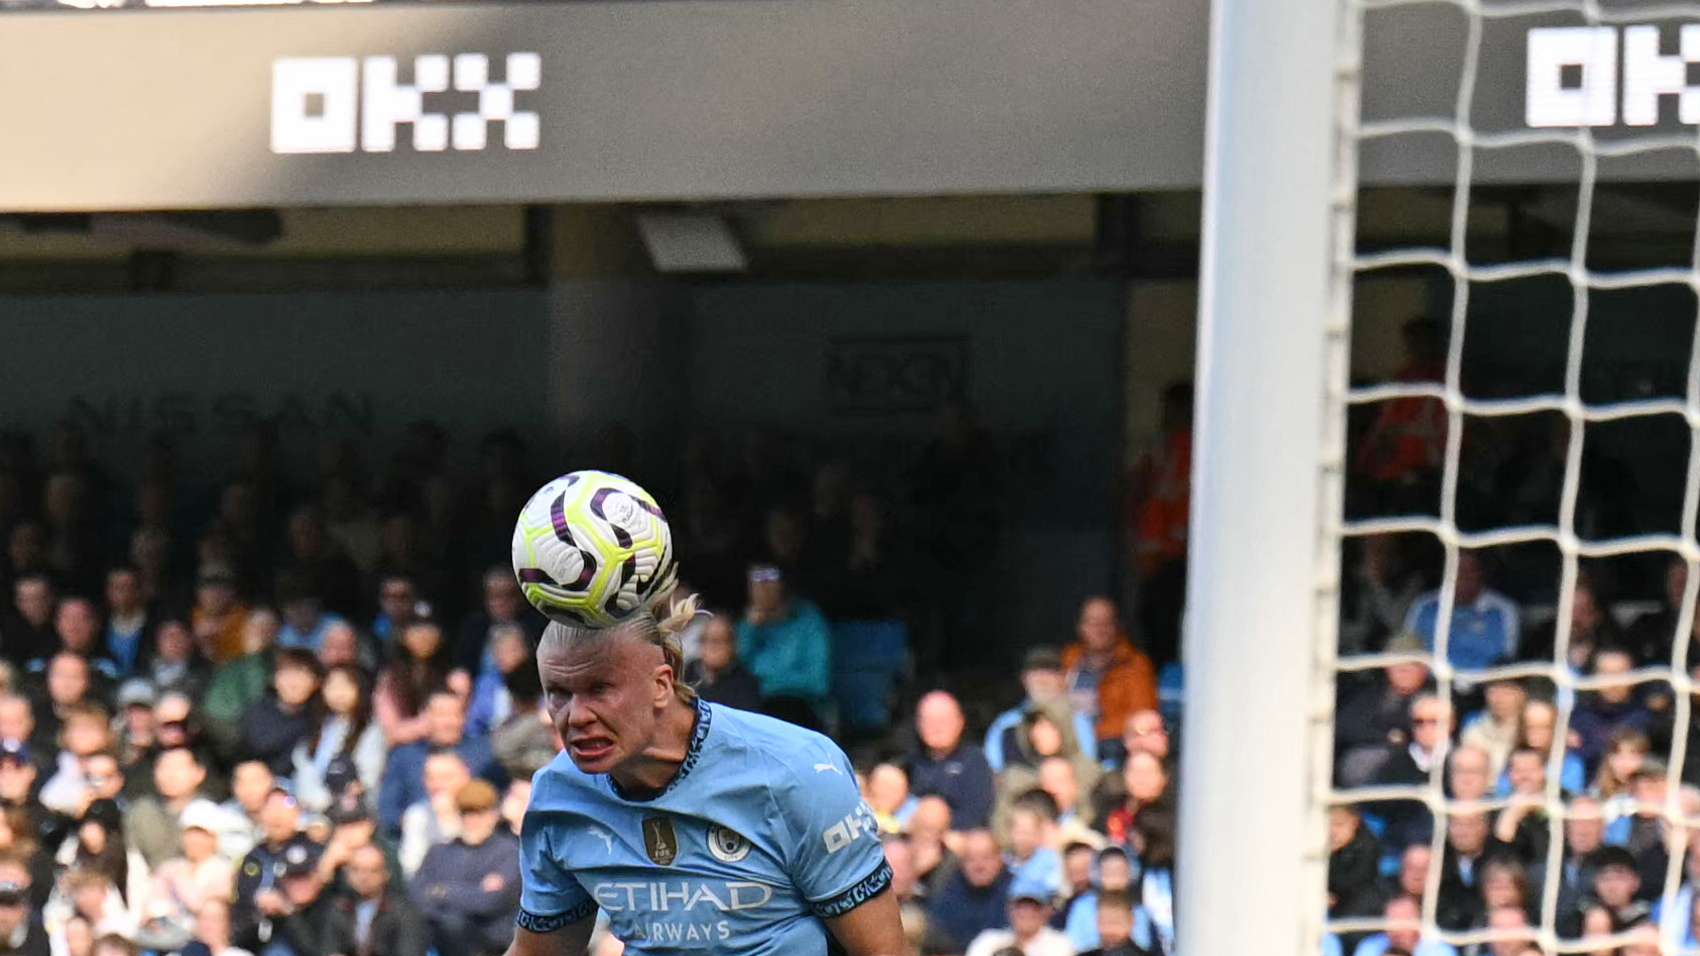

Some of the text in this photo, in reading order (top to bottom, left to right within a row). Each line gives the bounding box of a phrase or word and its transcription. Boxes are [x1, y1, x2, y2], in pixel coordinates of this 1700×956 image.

[271, 53, 540, 153] OKX
[595, 881, 773, 912] ETIHAD
[635, 920, 731, 943] AIRWAYS
